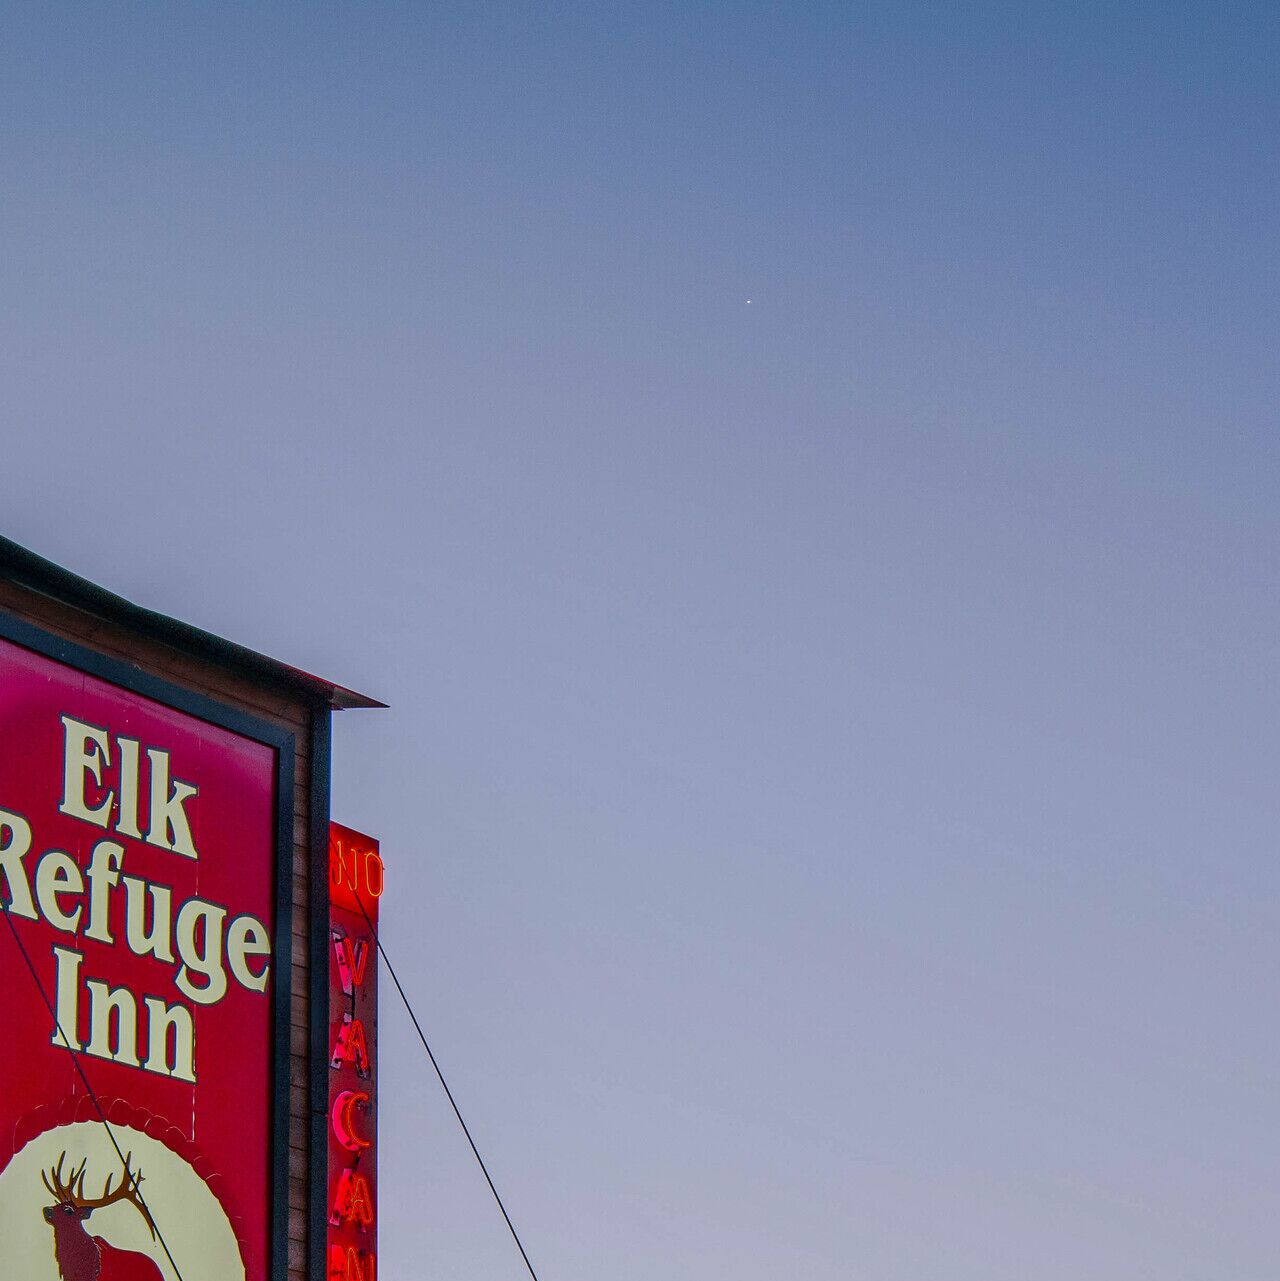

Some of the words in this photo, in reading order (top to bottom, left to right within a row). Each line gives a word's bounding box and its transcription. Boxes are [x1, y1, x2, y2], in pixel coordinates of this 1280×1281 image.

[58, 714, 200, 861] Elk
[329, 840, 384, 897] NO
[50, 945, 198, 1084] Inn
